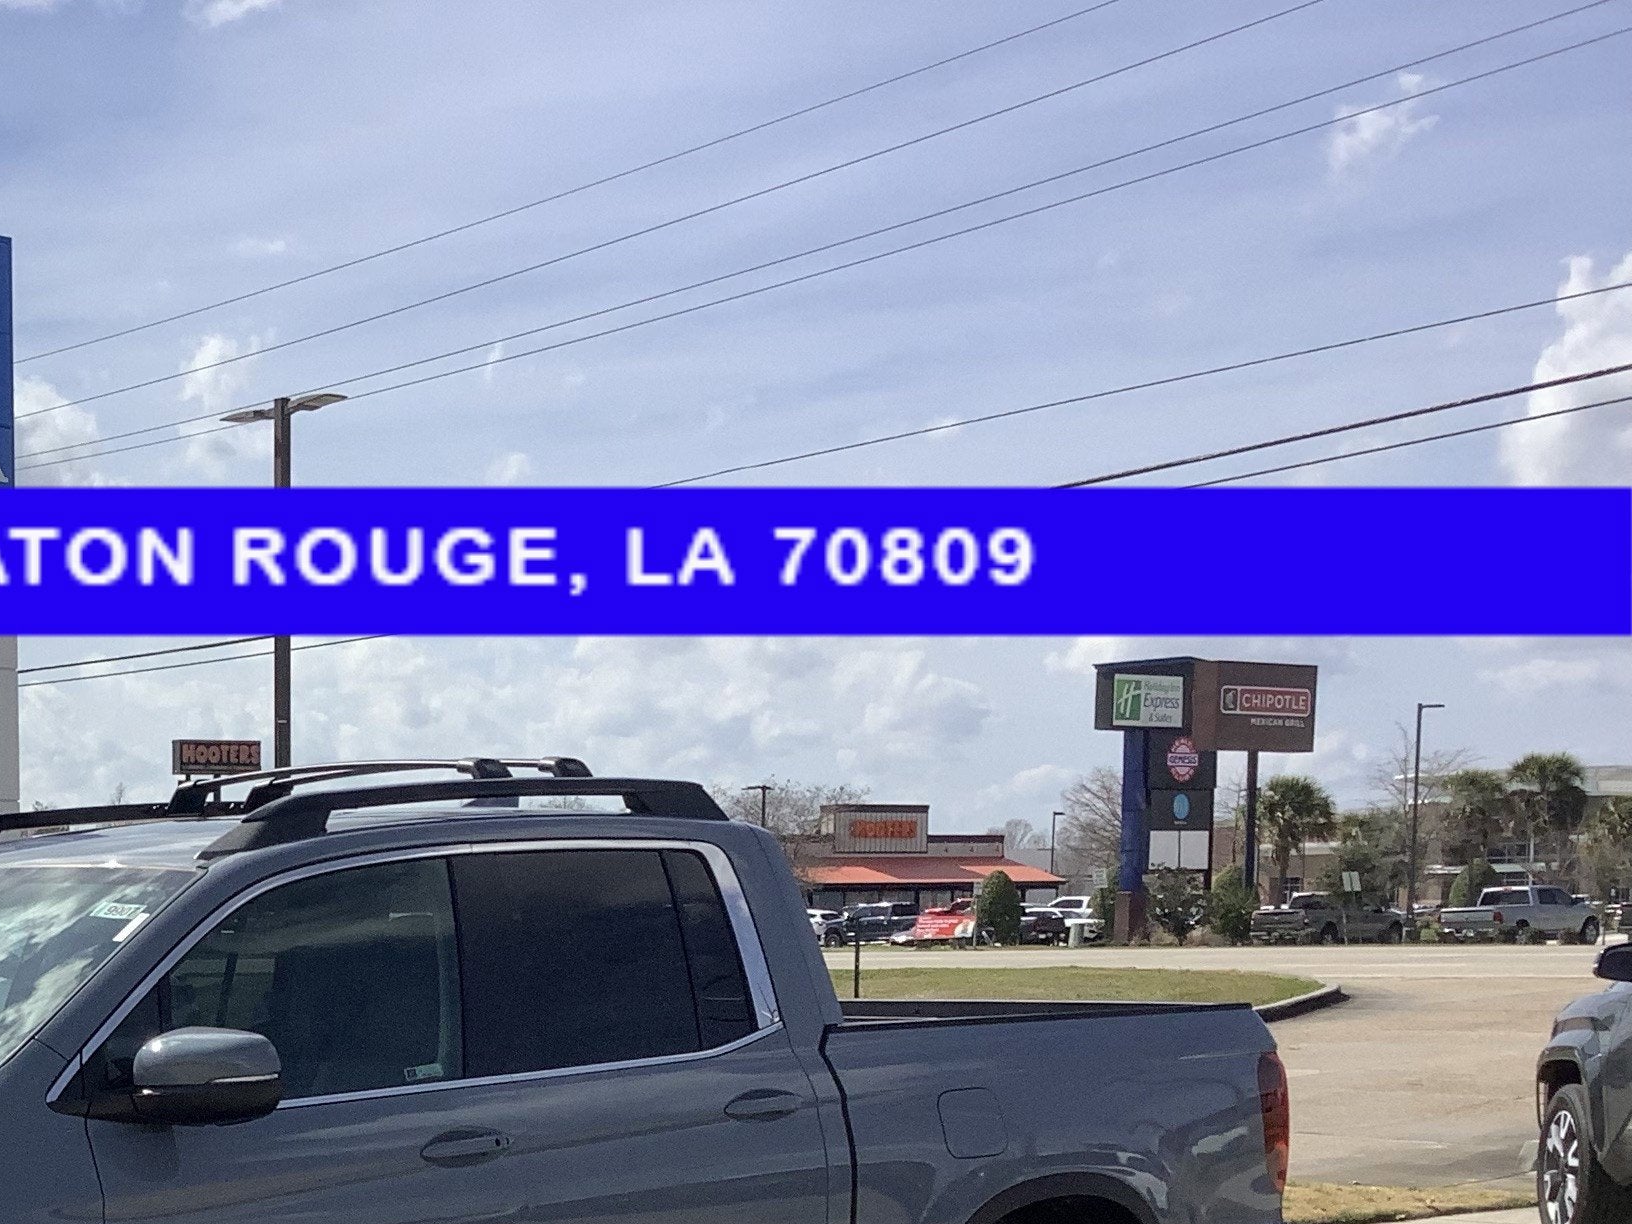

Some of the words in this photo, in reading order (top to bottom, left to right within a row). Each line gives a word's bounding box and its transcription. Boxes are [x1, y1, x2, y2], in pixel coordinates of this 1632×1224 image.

[1144, 692, 1180, 711] Express
[1241, 693, 1308, 711] CHIPOTLE
[1250, 717, 1283, 727] MEXICAN
[181, 743, 259, 765] HOOTERS
